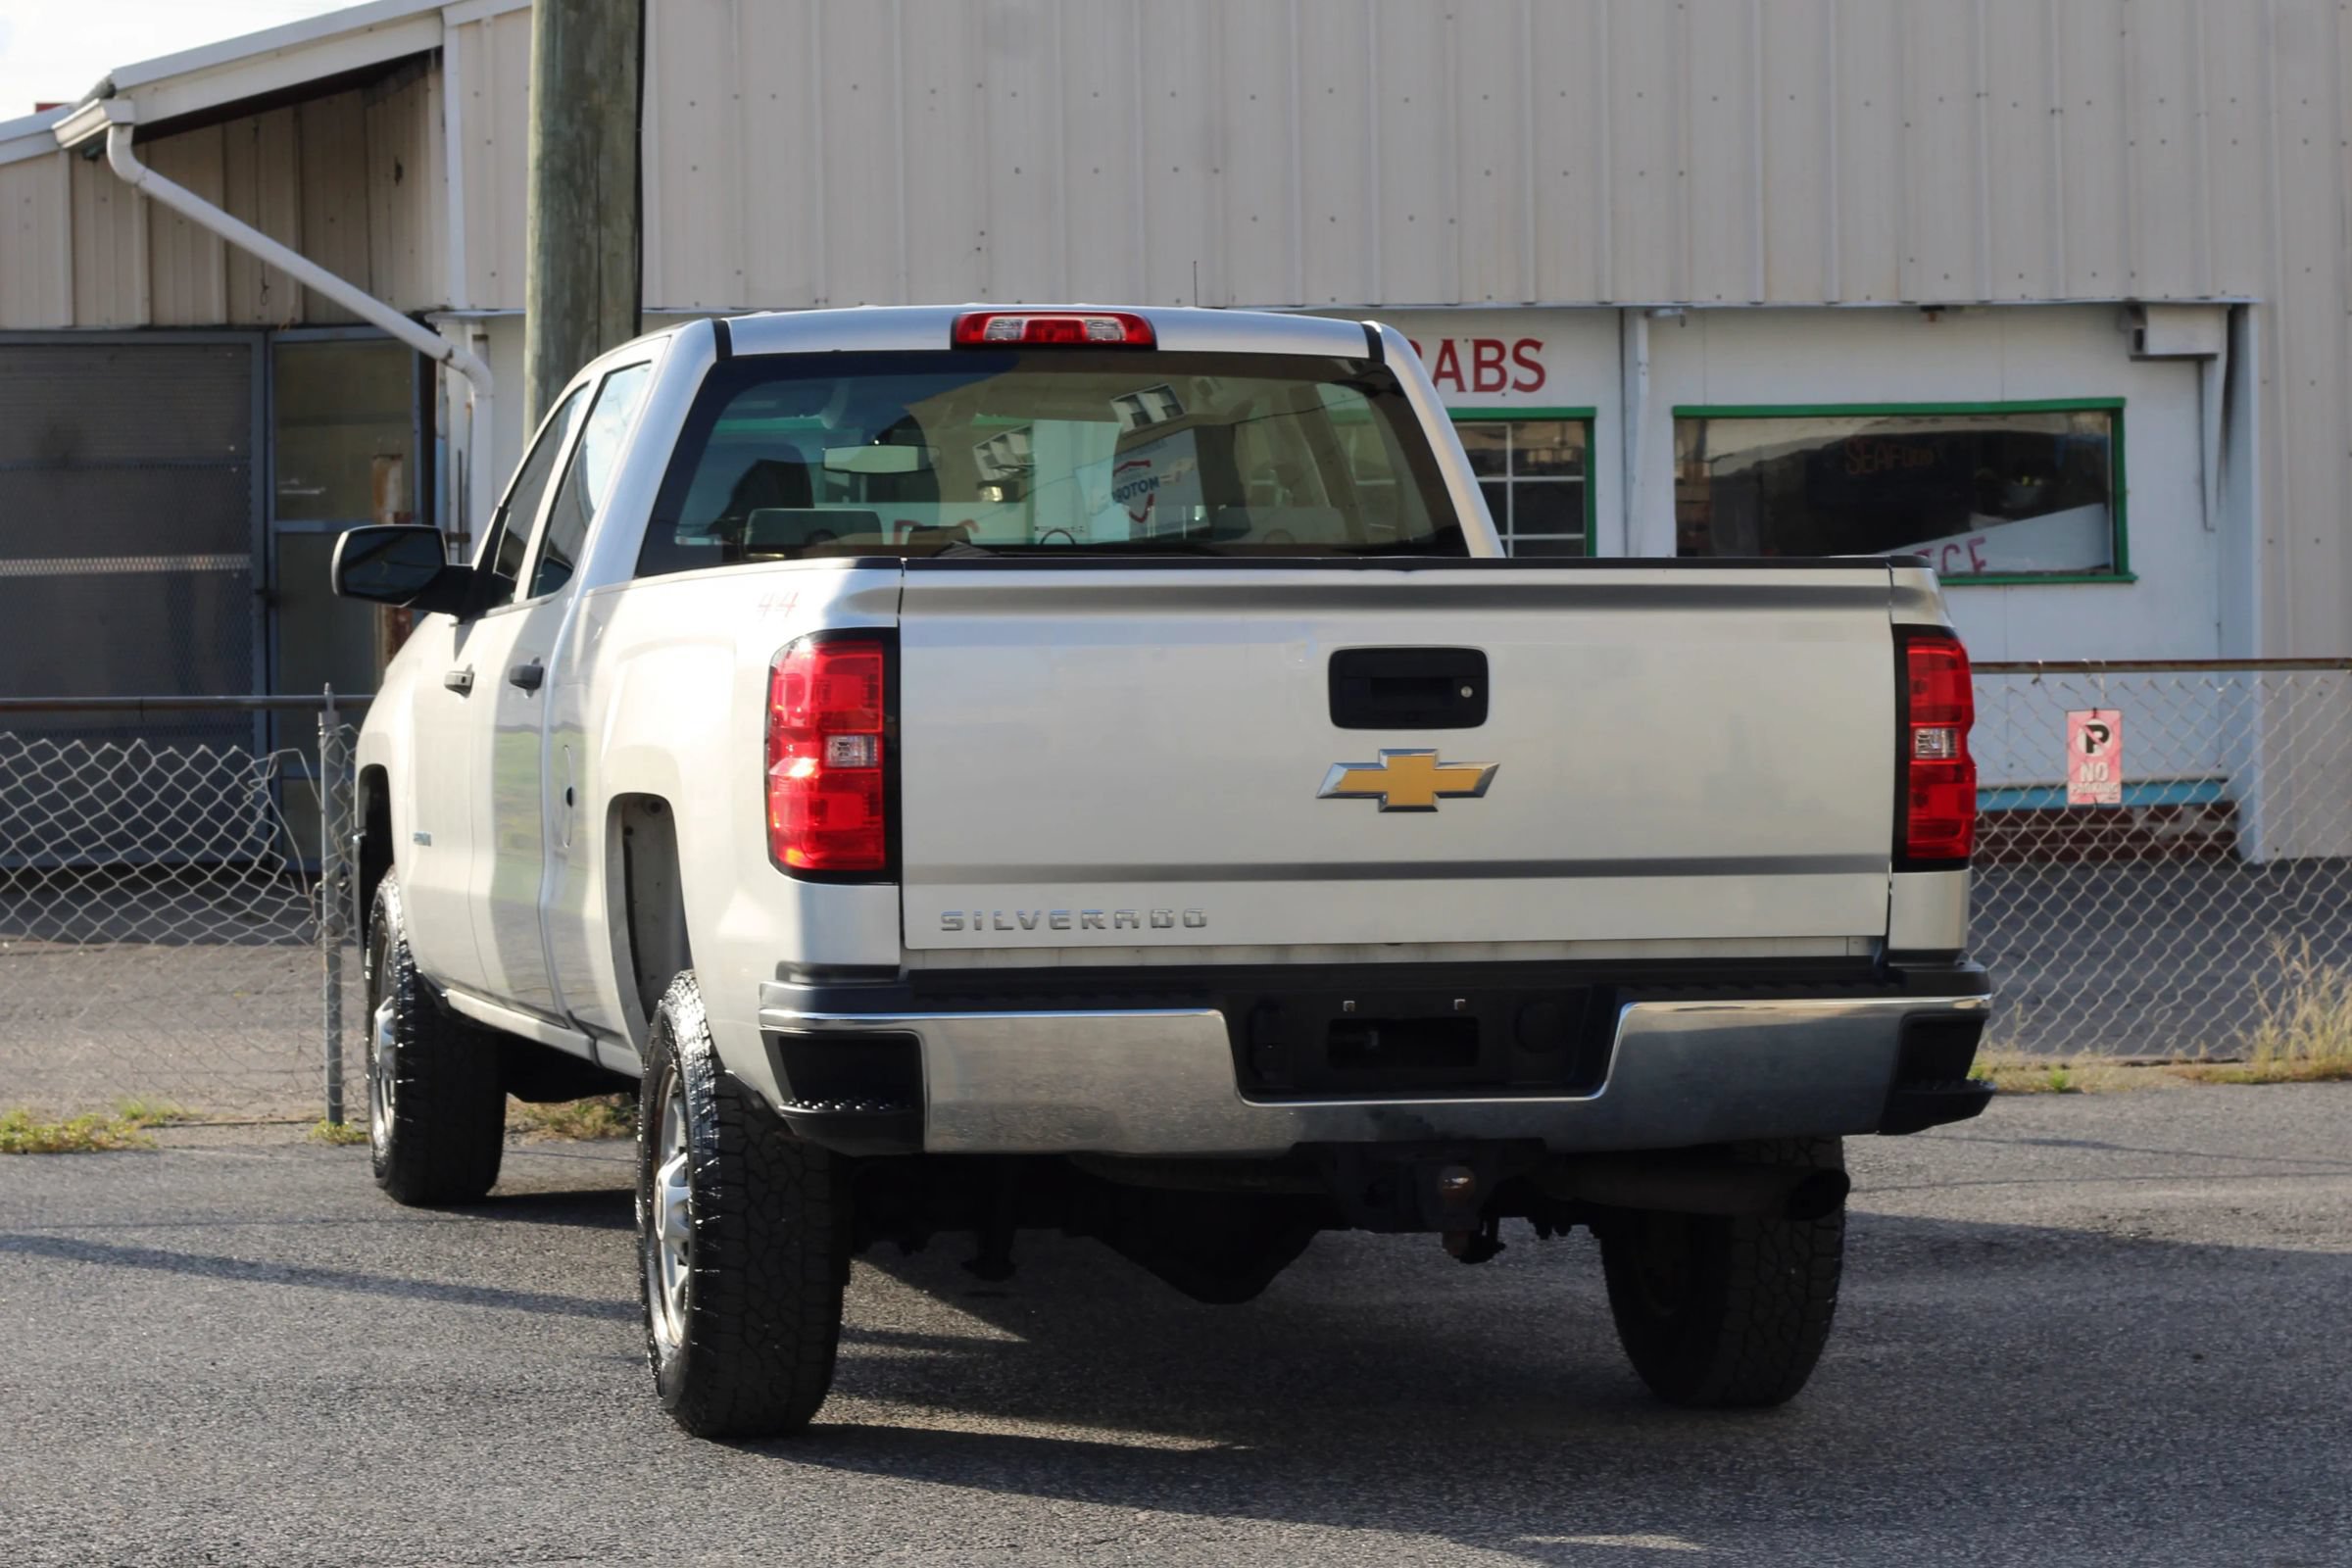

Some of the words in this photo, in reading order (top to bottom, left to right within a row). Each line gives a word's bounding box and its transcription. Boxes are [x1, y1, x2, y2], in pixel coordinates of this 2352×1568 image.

[1408, 338, 1545, 393] ABS
[2081, 761, 2109, 783] NO
[940, 908, 1207, 931] SILVERADO
